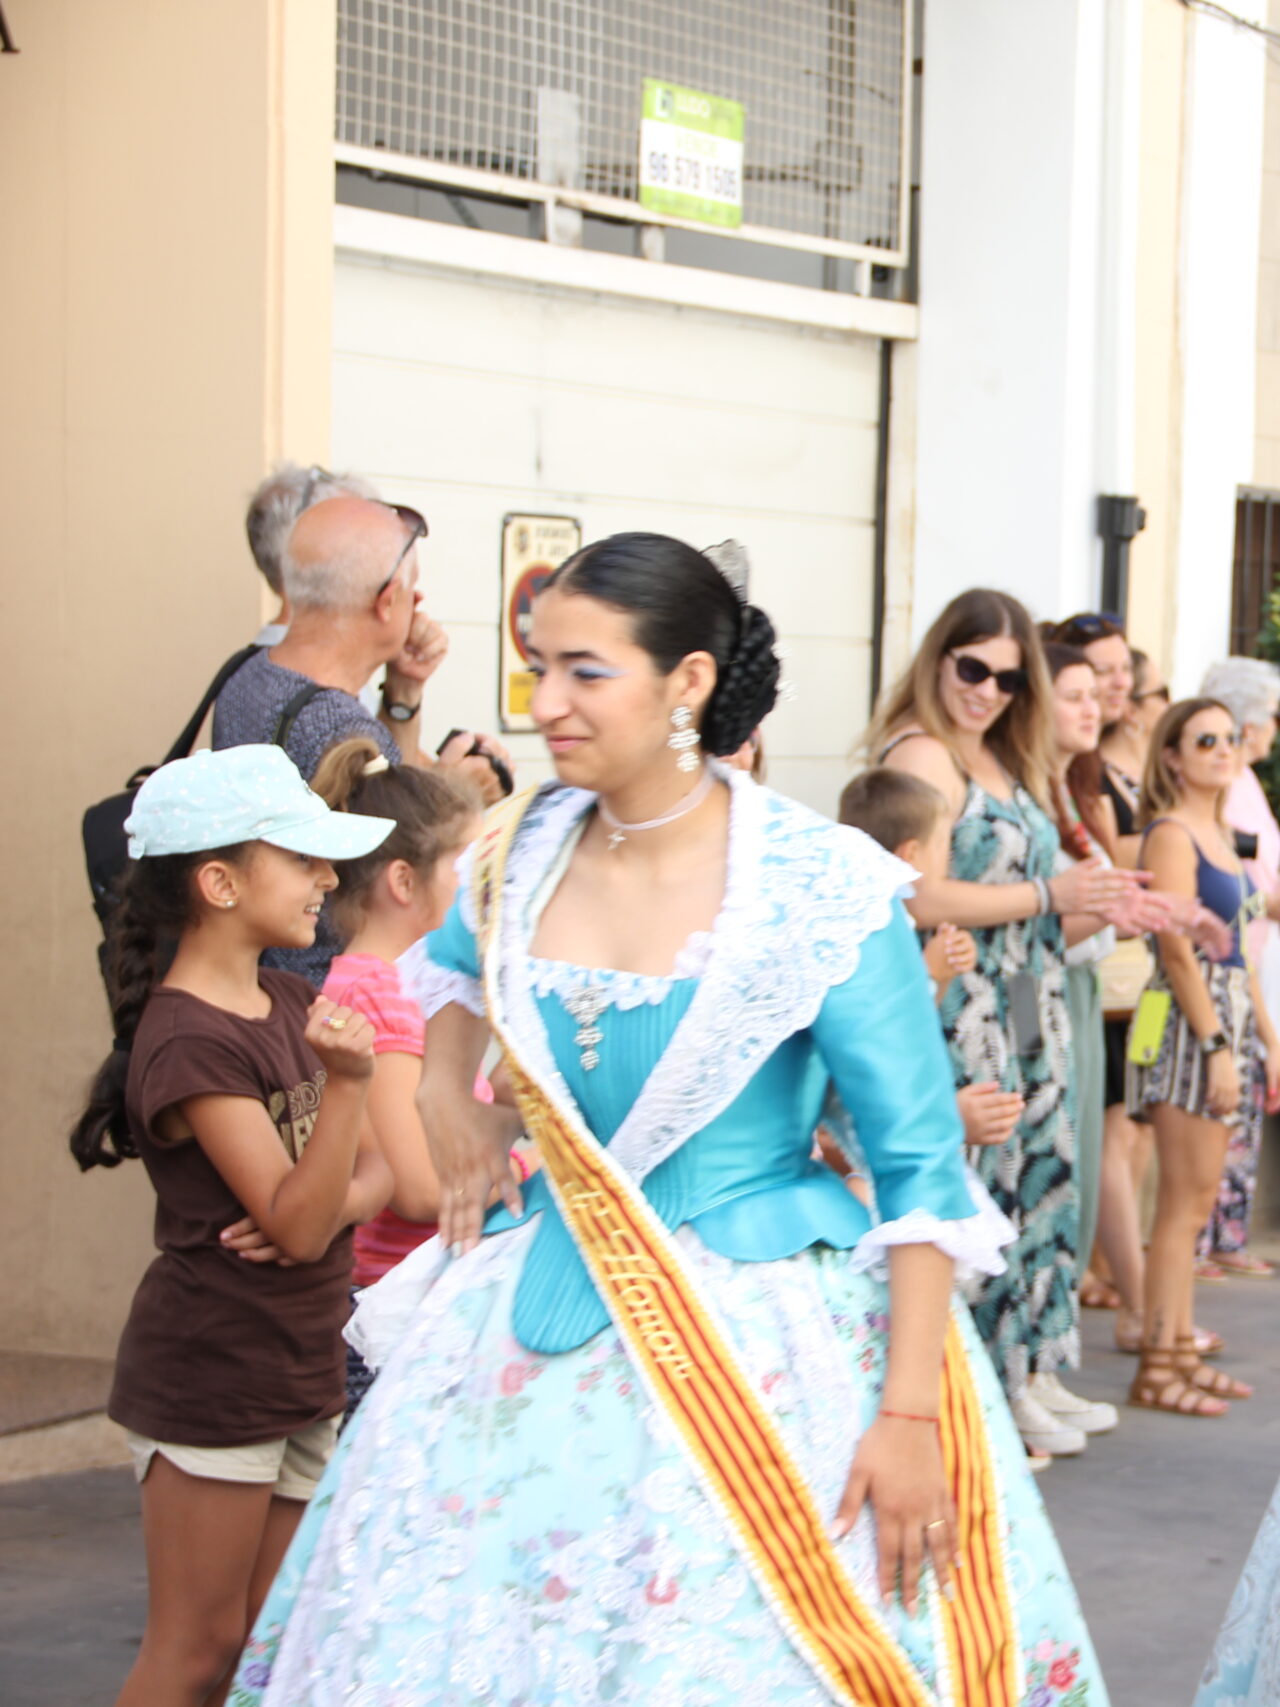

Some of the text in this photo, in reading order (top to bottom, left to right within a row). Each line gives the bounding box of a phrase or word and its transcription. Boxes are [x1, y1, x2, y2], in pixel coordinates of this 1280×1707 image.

[648, 151, 670, 183] 96
[675, 155, 699, 189] 579
[598, 1228, 694, 1380] Honor
